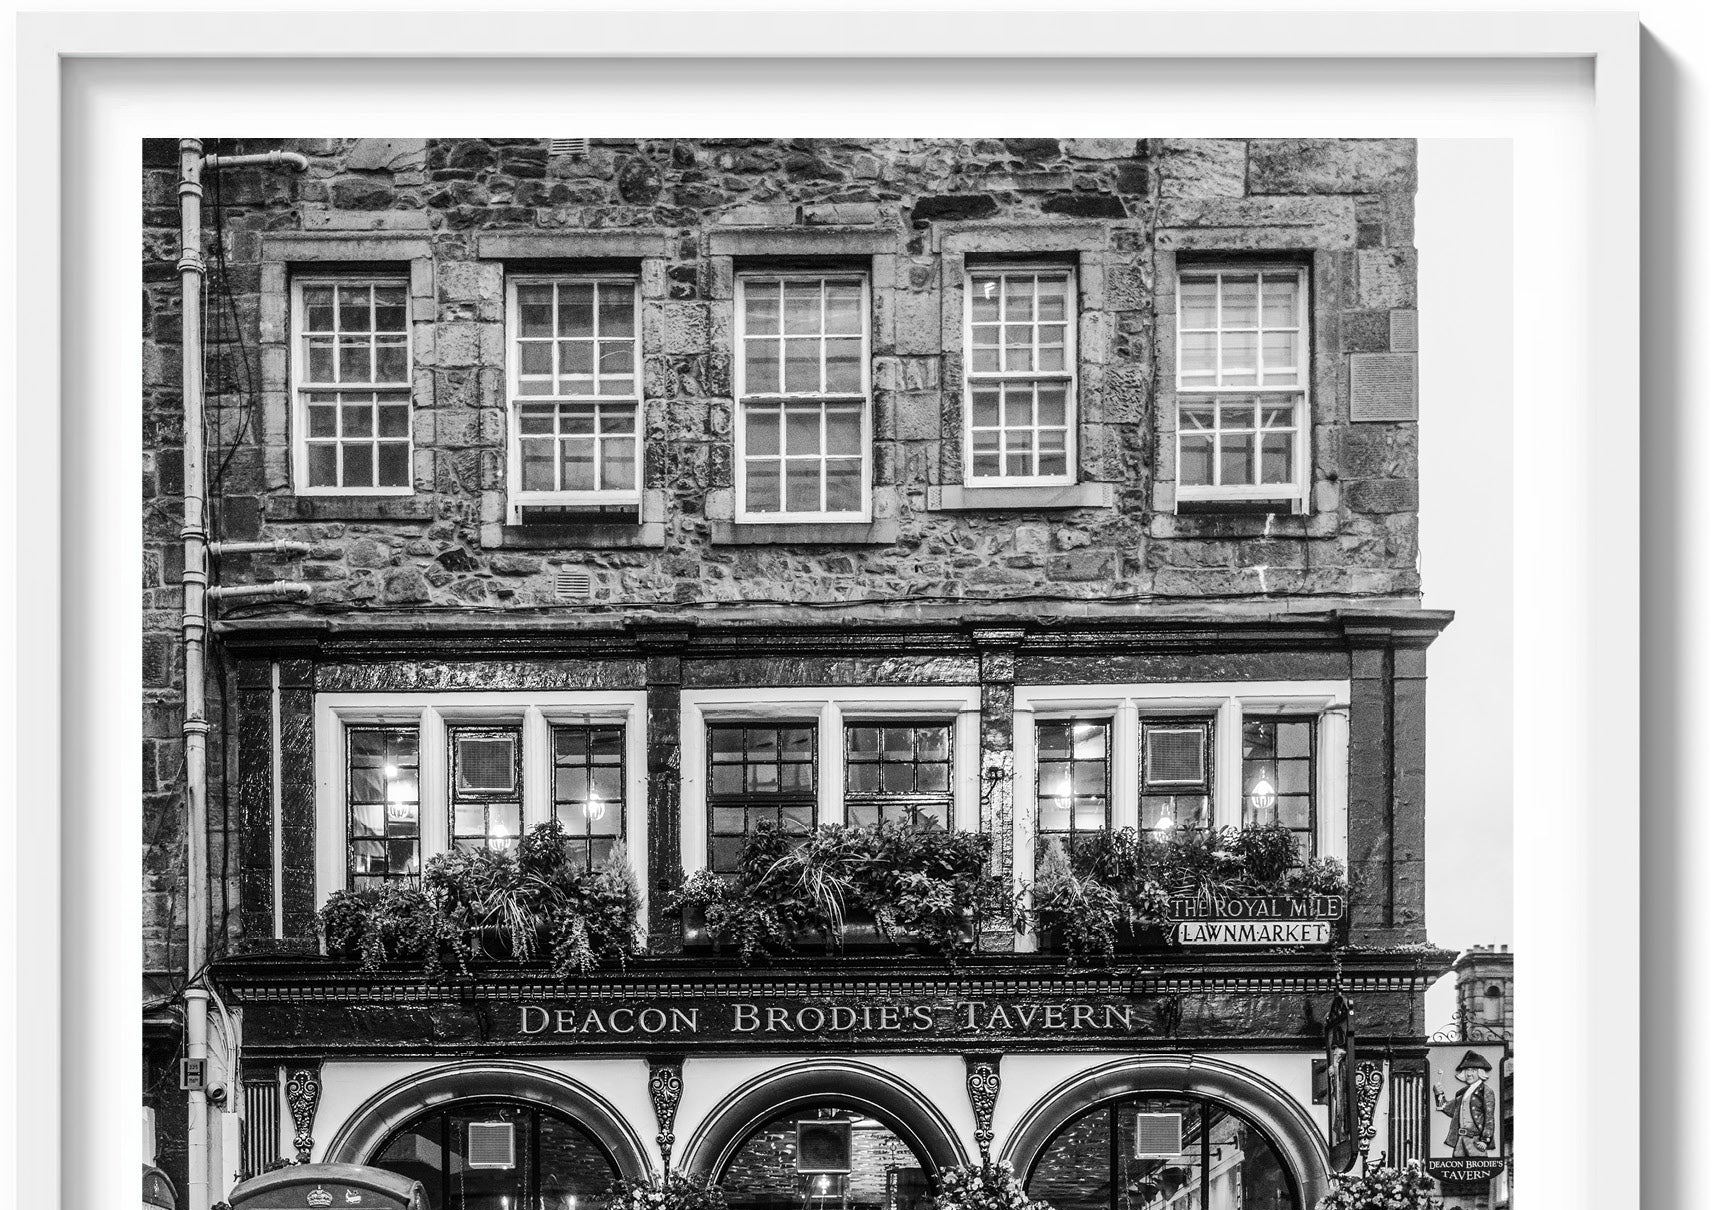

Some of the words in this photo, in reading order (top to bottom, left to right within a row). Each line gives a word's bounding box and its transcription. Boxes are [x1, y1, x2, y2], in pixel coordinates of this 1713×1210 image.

[1170, 899, 1210, 917] THE
[1215, 899, 1282, 917] ROYAL
[1290, 899, 1339, 916] MILE
[1182, 924, 1326, 942] LAWNMARKET
[517, 1005, 699, 1034] DEACON
[730, 1003, 934, 1033] BRODIE'S
[956, 1001, 1132, 1031] TAVERN
[1429, 1160, 1464, 1170] DEACON
[1465, 1160, 1504, 1169] BRODIE'S
[1441, 1170, 1491, 1181] TAVERN
